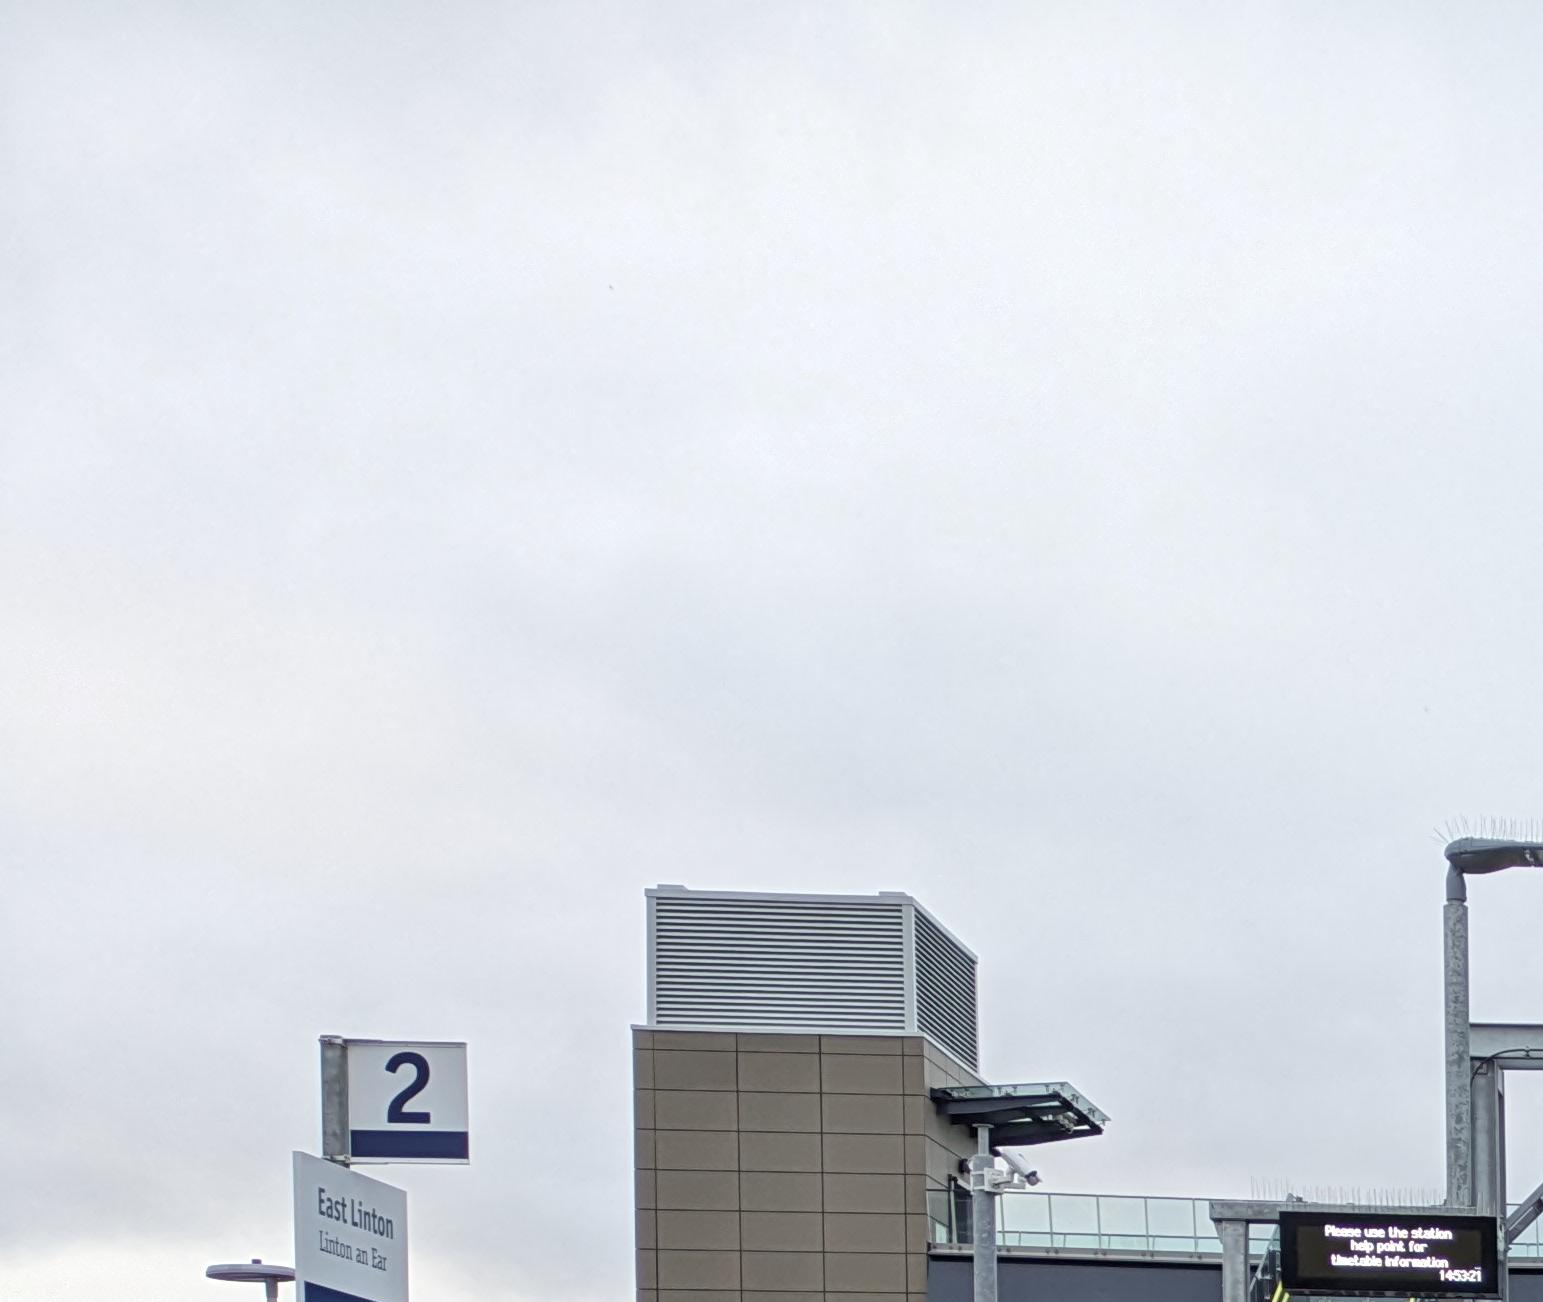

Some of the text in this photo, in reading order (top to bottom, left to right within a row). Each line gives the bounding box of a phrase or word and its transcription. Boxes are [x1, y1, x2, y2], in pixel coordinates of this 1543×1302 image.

[384, 1051, 431, 1124] 2
[318, 1187, 394, 1240] East Linton
[1325, 1224, 1453, 1240] Please use the station
[1350, 1239, 1428, 1253] help point for
[319, 1230, 387, 1271] Linton an Ear
[1331, 1254, 1449, 1268] timetable information
